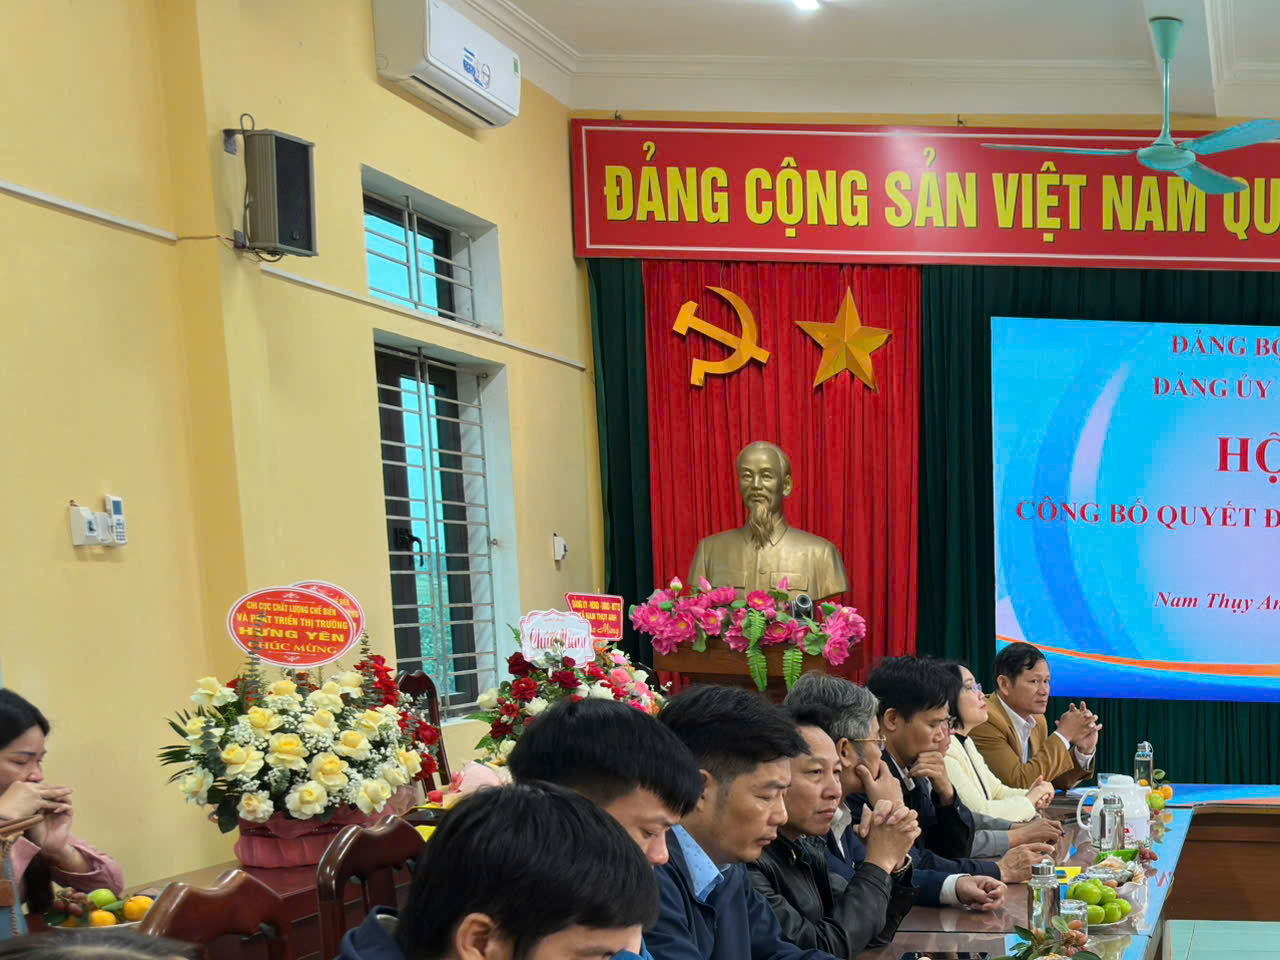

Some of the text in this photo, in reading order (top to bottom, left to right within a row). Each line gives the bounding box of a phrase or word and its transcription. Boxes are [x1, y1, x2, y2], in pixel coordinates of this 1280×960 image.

[603, 141, 729, 223] ĐẢNG
[745, 156, 869, 237] CỘNG
[885, 147, 977, 229] SẢN
[992, 161, 1087, 243] VIỆT
[1102, 174, 1206, 234] NAM
[1171, 329, 1247, 356] ĐẢNG
[1154, 371, 1228, 398] ĐẢNG
[1237, 373, 1272, 399] ỦY
[1016, 496, 1100, 523] CÔNG
[1157, 501, 1256, 530] QUYẾT
[1155, 591, 1199, 608] Nam
[1207, 593, 1254, 614] Thụy
[304, 631, 345, 642] YÊN
